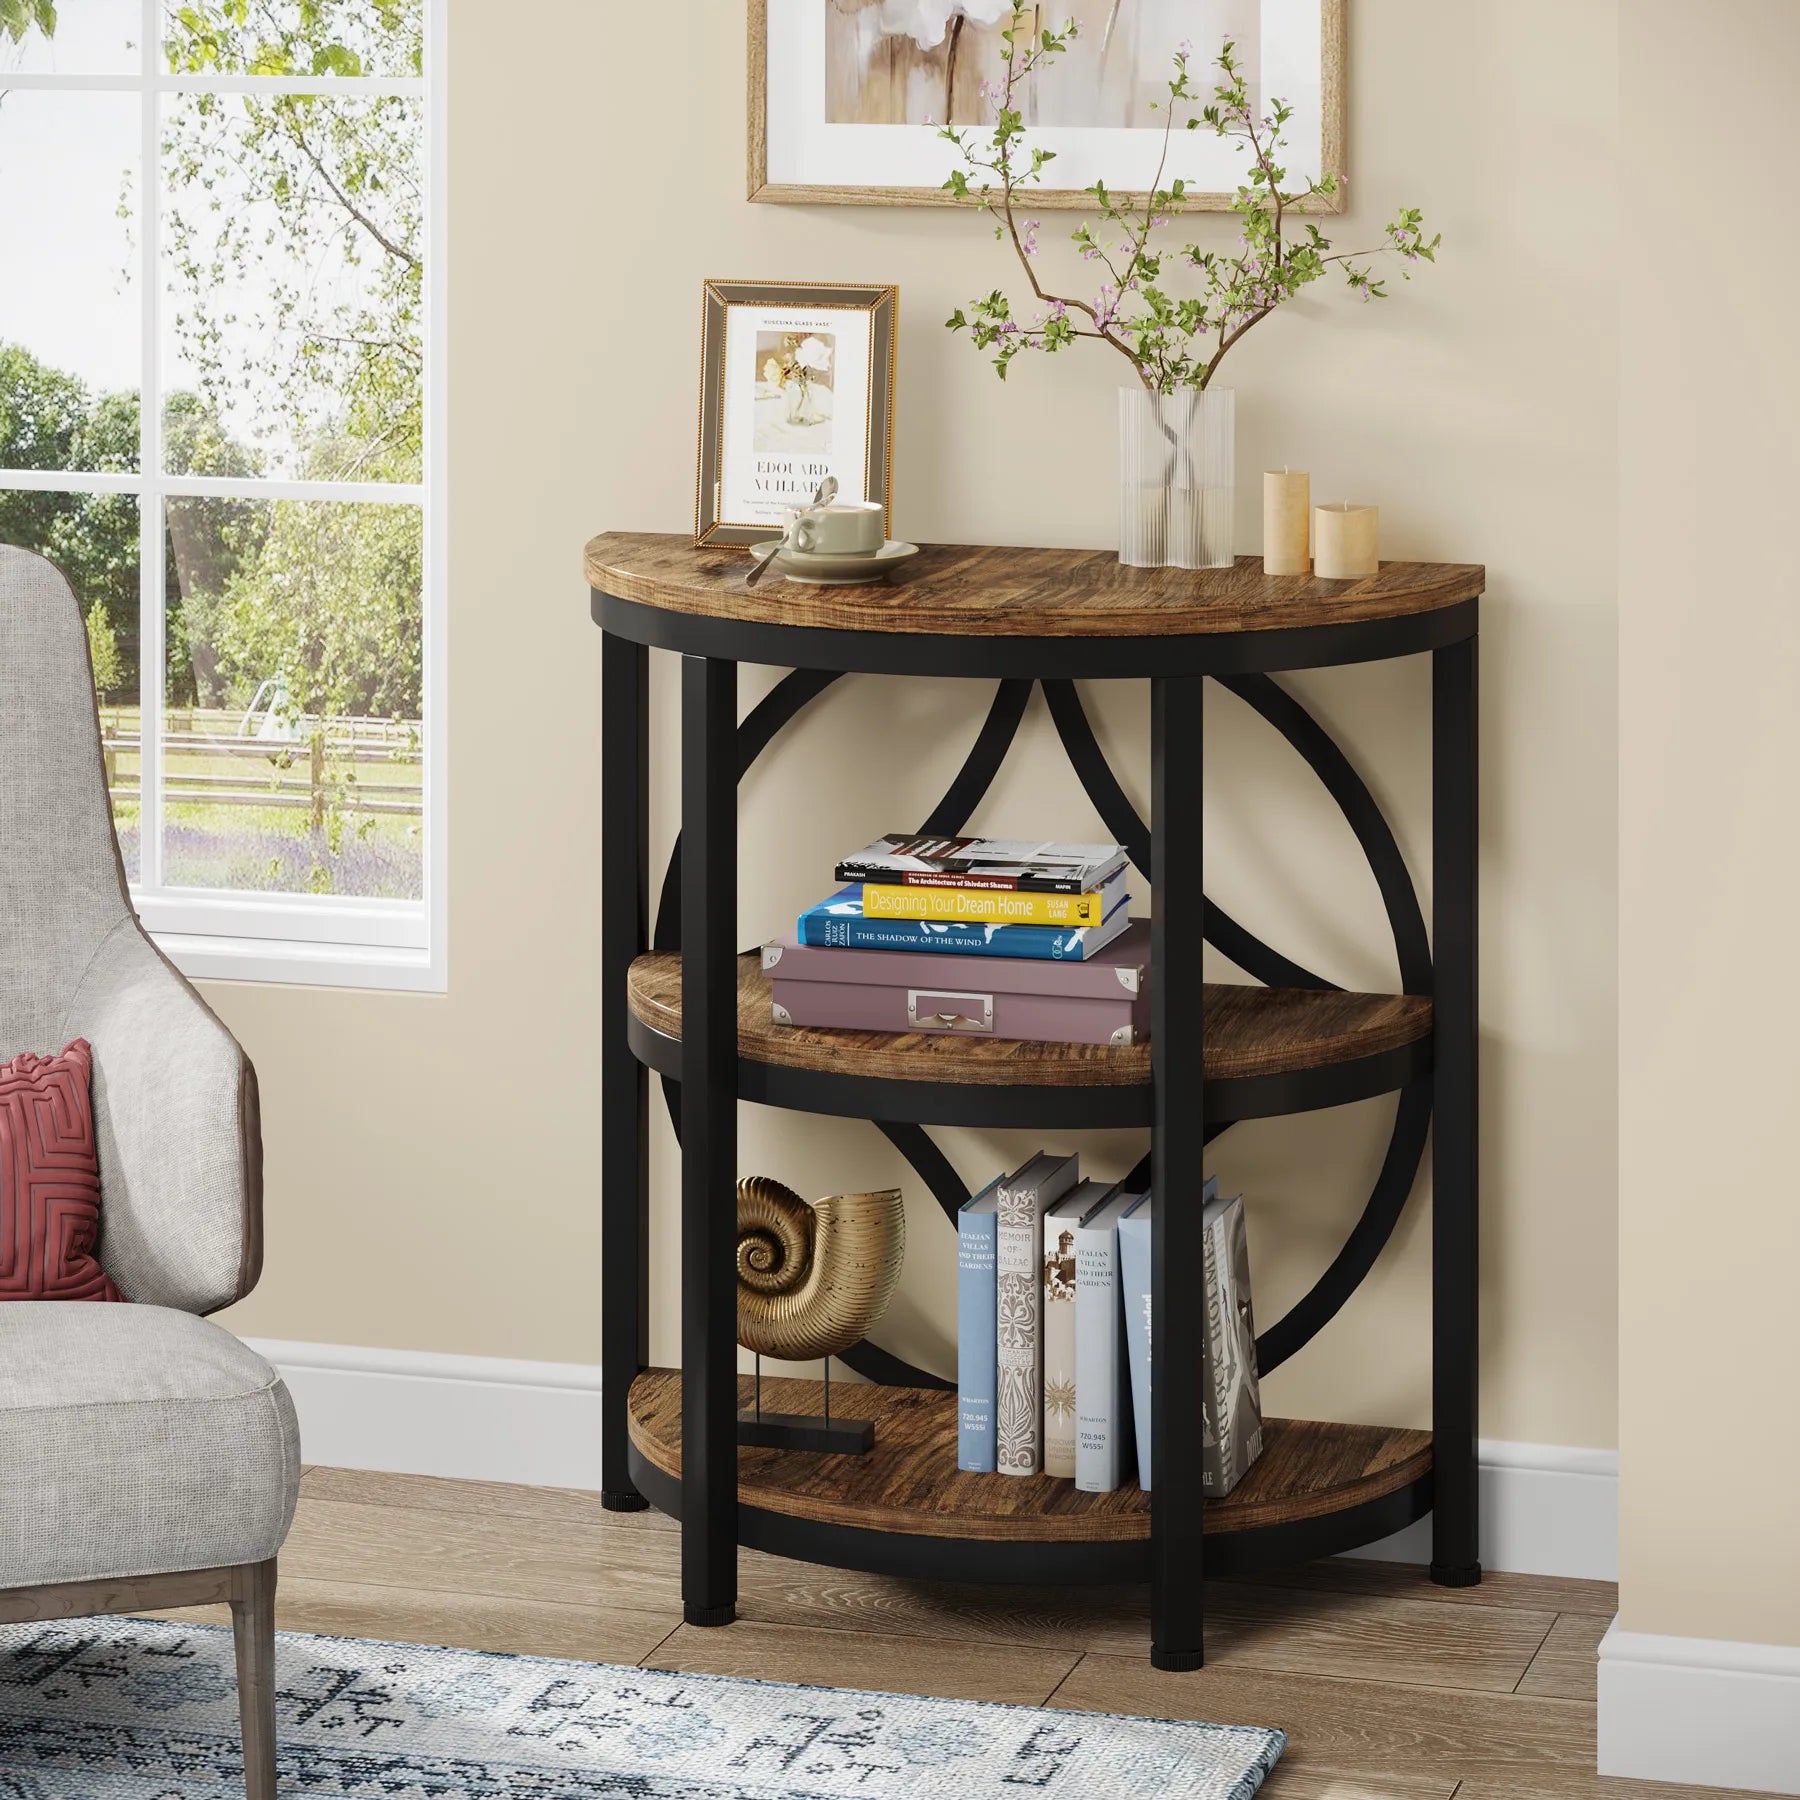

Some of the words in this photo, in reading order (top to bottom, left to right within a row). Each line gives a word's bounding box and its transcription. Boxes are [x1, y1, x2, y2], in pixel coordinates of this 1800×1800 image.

[757, 461, 829, 475] EDOUARD
[755, 479, 818, 493] VUILLAR
[920, 878, 956, 886] Architecture
[964, 879, 989, 889] Shivdatt
[990, 881, 1013, 890] Sharma
[870, 890, 927, 916] Designing
[929, 893, 955, 913] Your
[957, 894, 995, 914] Dream
[998, 896, 1034, 916] Home
[1046, 900, 1069, 909] SUSAN
[1048, 909, 1067, 918] LANG
[856, 932, 875, 940] THE
[877, 933, 918, 942] SHADOW
[955, 938, 982, 946] WIND
[960, 1232, 991, 1240] ITALIAN
[999, 1231, 1031, 1242] MEMOIR
[962, 1242, 989, 1250] VILLAS
[1078, 1249, 1109, 1257] ITALIAN
[959, 1261, 993, 1270] GARDENS
[999, 1256, 1029, 1267] BALZAC
[1080, 1259, 1107, 1267] VILLAS
[1077, 1279, 1111, 1287] GARDENS
[1203, 1223, 1221, 1342] HOLMES
[962, 1413, 988, 1422] 720.945
[1211, 1343, 1234, 1496] SHERLOCK
[1080, 1432, 1106, 1441] 720.945
